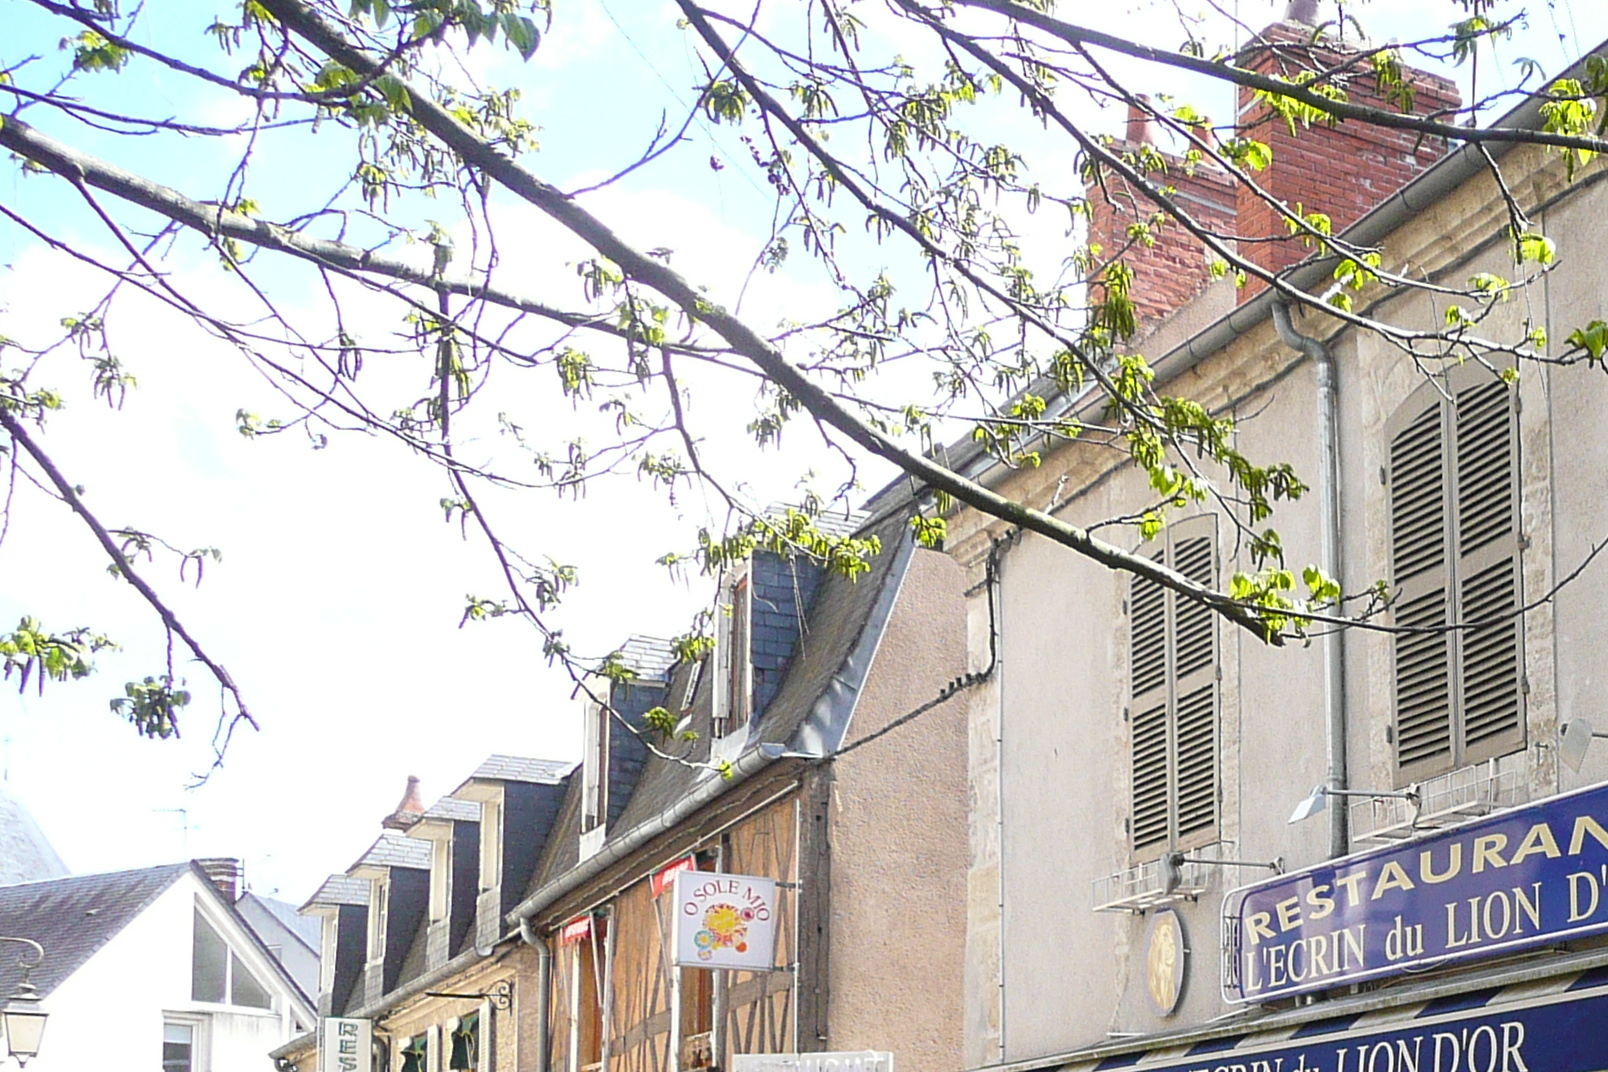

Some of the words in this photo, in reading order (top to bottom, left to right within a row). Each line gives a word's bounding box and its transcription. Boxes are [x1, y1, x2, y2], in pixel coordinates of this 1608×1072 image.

[683, 901, 699, 916] O
[693, 880, 741, 902] SOLE
[742, 886, 770, 922] MIO
[1245, 924, 1366, 993] L'ECRIN
[1385, 915, 1424, 959] du
[1445, 882, 1543, 949] LION
